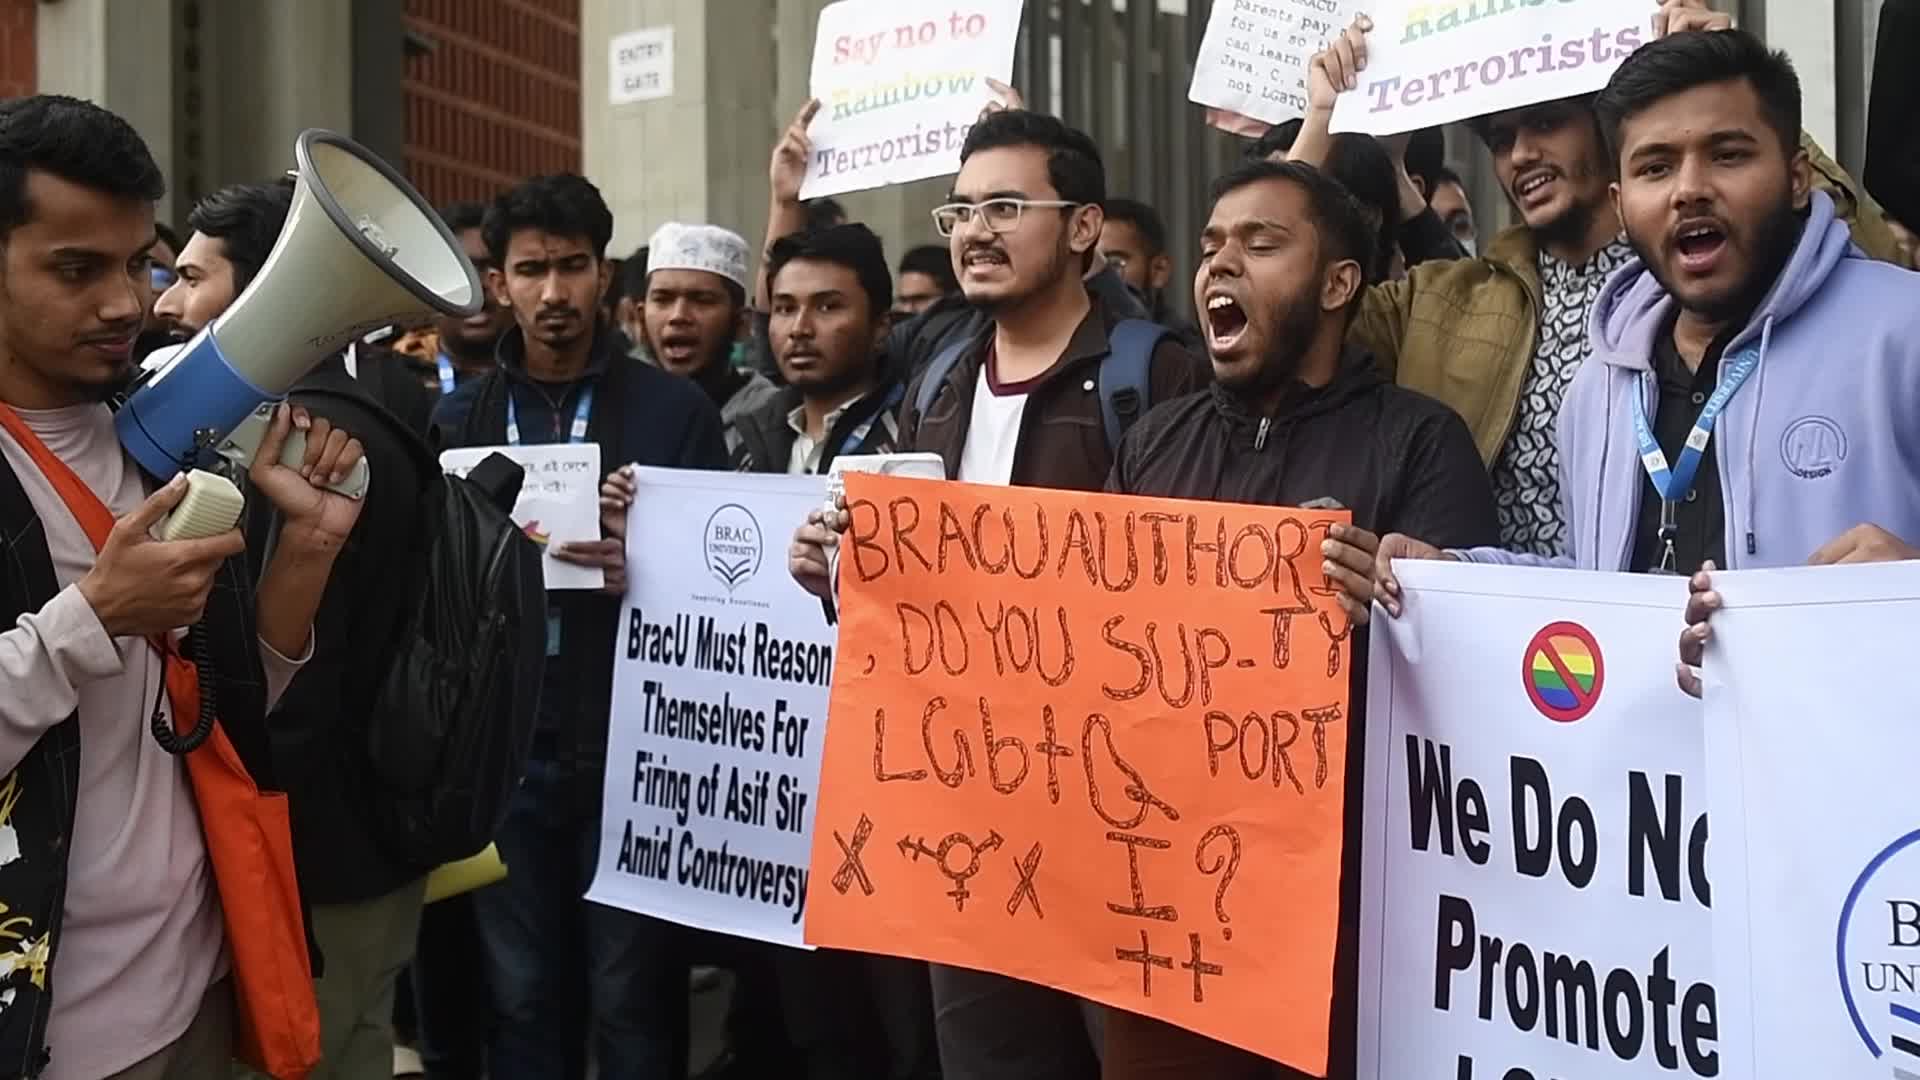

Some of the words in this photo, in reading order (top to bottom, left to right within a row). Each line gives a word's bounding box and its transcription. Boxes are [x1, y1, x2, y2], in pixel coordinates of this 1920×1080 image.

[833, 31, 885, 64] Say
[895, 20, 937, 49] no
[949, 11, 986, 39] to
[1225, 37, 1250, 51] can
[1258, 45, 1302, 66] learn
[1230, 16, 1255, 33] for
[1264, 27, 1280, 40] us
[1288, 34, 1306, 48] so
[1234, 0, 1293, 23] parents
[1302, 17, 1331, 37] pay
[1227, 78, 1252, 94] not
[1368, 26, 1641, 113] Terrorists
[708, 543, 758, 557] UNIVERSITY
[715, 526, 753, 542] BRAC
[627, 607, 690, 667] BracU
[694, 615, 746, 676] Must
[753, 622, 832, 687] Reason
[896, 600, 969, 677] DO
[976, 599, 1075, 687] YOU
[643, 680, 765, 752] Themselves
[772, 699, 809, 758] For
[1203, 701, 1342, 795] PORT
[632, 750, 691, 827] Firing
[697, 763, 720, 817] of
[724, 766, 770, 827] Asif
[775, 773, 808, 833] Sir
[1406, 733, 1491, 865] We
[1510, 755, 1598, 888] Do
[616, 819, 673, 881] Amid
[677, 830, 809, 925] Controversy
[1433, 893, 1720, 1078] Promote
